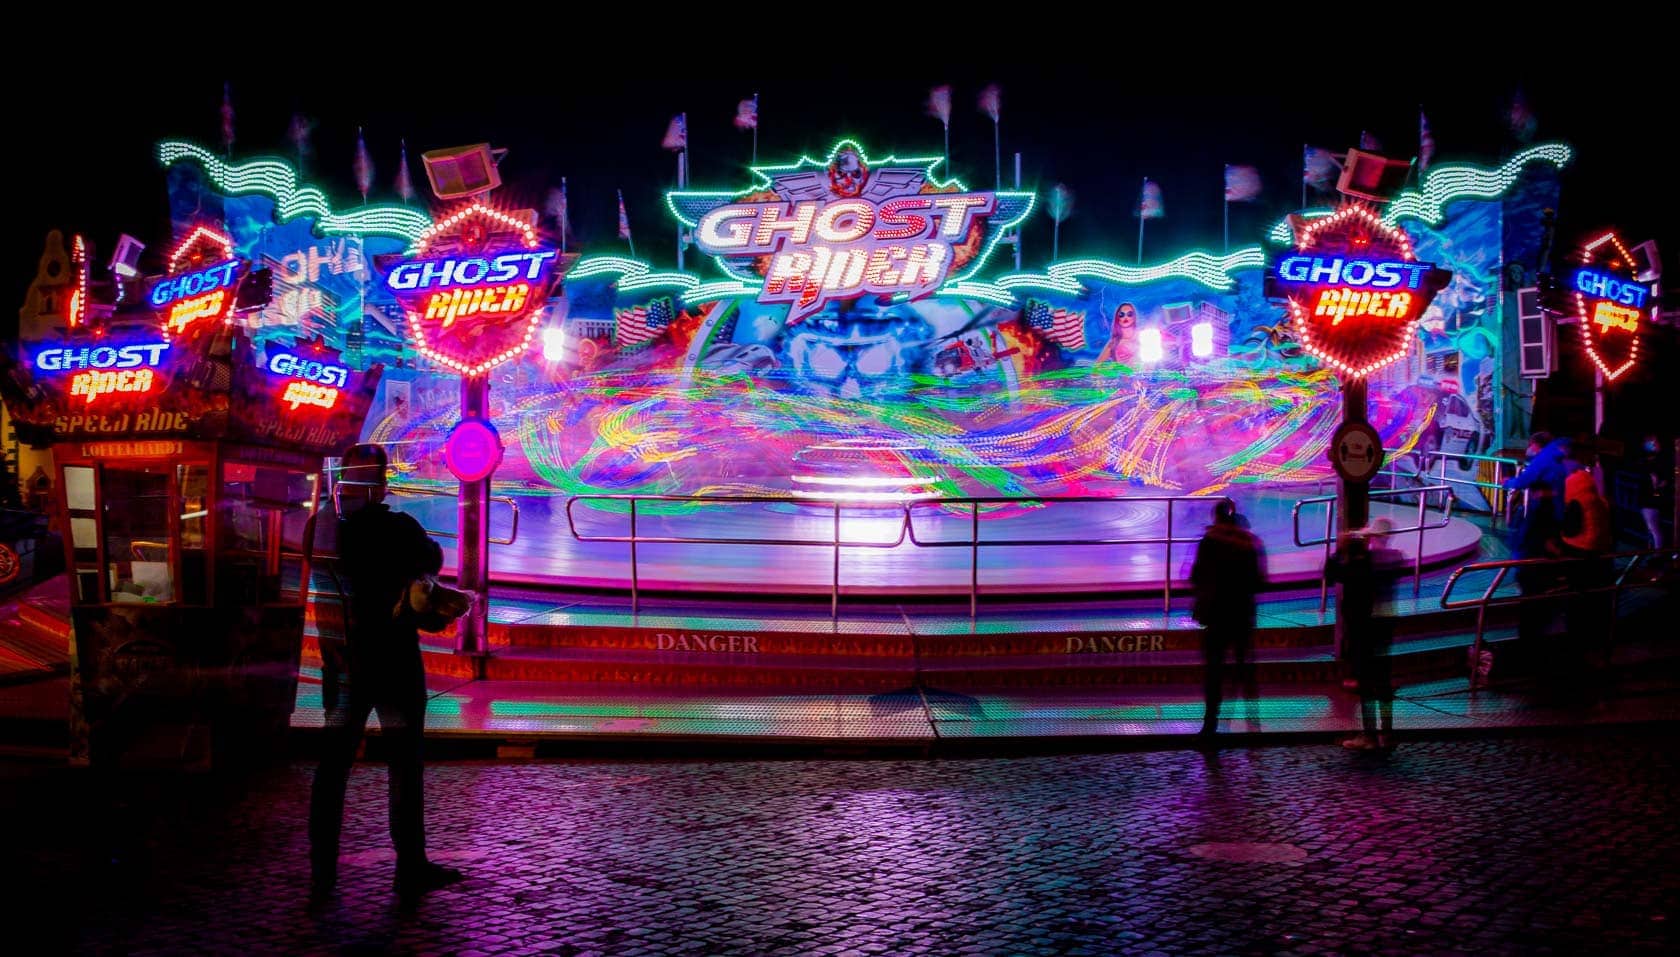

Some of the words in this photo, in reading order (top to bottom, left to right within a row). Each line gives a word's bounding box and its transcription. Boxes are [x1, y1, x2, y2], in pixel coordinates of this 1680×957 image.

[698, 193, 990, 248] GHOST
[151, 261, 240, 307] GHOST
[387, 251, 556, 290] GHOST
[766, 243, 947, 309] RIDER
[1278, 256, 1432, 288] GHOST
[1576, 270, 1648, 306] GHOST
[424, 284, 531, 328] RIDER
[1314, 287, 1413, 325] RIDER
[35, 344, 171, 371] GHOST
[269, 353, 349, 387] GHOST
[70, 368, 155, 403] RIDER
[54, 413, 130, 434] SPEED
[135, 405, 190, 432] RIDE
[655, 632, 760, 654] DANGER
[1064, 634, 1165, 655] DANGER
